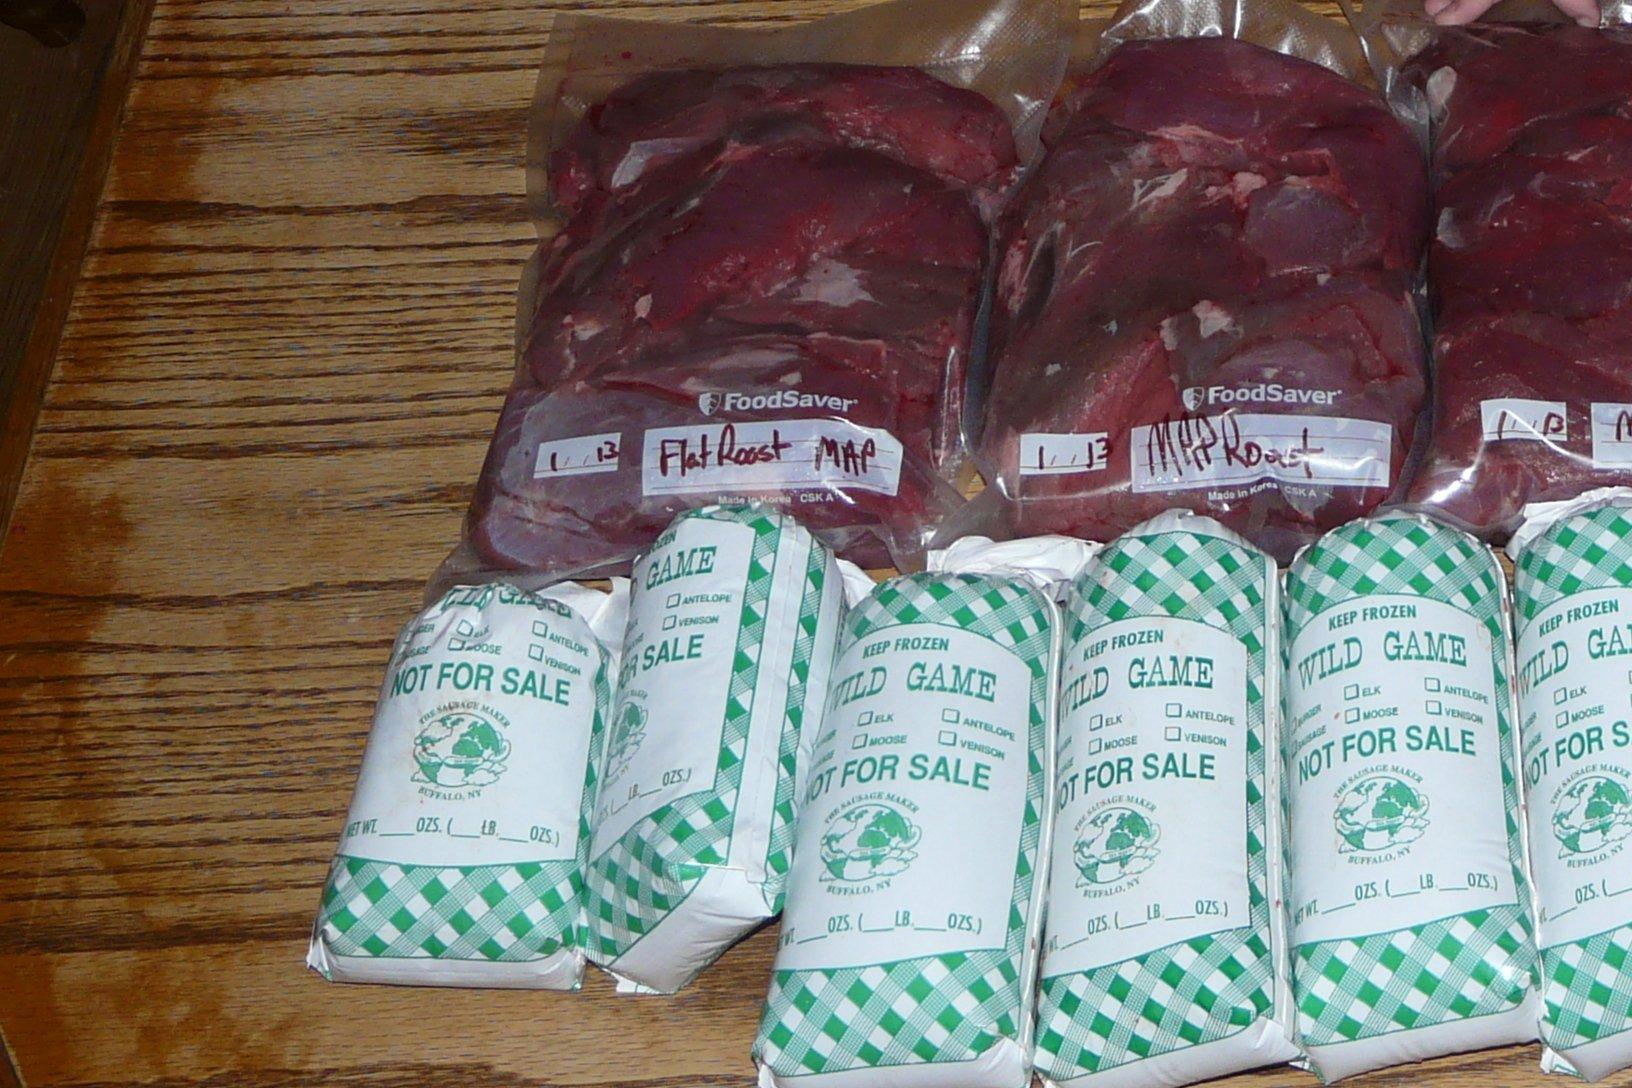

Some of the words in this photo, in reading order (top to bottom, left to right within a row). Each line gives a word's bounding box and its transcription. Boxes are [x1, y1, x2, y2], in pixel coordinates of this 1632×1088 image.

[724, 391, 853, 412] FoodSaver
[1208, 385, 1336, 405] FoodSaver
[597, 441, 619, 462] 13
[660, 439, 709, 477] Flat
[717, 424, 792, 467] Roast
[815, 436, 876, 476] MAP
[1208, 490, 1235, 500] Made
[1238, 488, 1248, 497] in
[1250, 482, 1278, 497] Korea
[646, 546, 717, 591] GAME
[682, 593, 732, 605] ANTELOPE
[678, 615, 719, 627] VENISON
[1329, 611, 1358, 631] KEEP
[1362, 605, 1416, 621] FROZEN
[1539, 615, 1563, 637] KEEP
[1567, 599, 1619, 623] FROZEN
[642, 634, 704, 671] SALE
[862, 641, 890, 659] KEEP
[894, 638, 949, 652] FROZEN
[1083, 640, 1108, 662] KEEP
[1112, 630, 1164, 650] FROZEN
[1299, 637, 1362, 690] WILD
[1384, 630, 1467, 667] GAME
[390, 665, 432, 697] NOT
[436, 662, 494, 691] FOR
[501, 668, 571, 706] SALE
[906, 661, 997, 703] GAME
[1129, 656, 1214, 689] GAME
[1519, 640, 1569, 699] WILD
[1570, 687, 1587, 699] ELK
[436, 701, 480, 714] SAUSAGE
[480, 704, 511, 729] MAKER
[1105, 715, 1123, 727] ELK
[1186, 710, 1235, 726] ANTELOPE
[1572, 705, 1605, 723] MOOSE
[869, 735, 908, 746] MOOSE
[960, 739, 1005, 760] VENISON
[1104, 736, 1138, 751] MOOSE
[1184, 733, 1227, 747] VENISON
[1299, 741, 1334, 786] NOT
[1343, 728, 1396, 762] FOR
[1406, 726, 1476, 756] SALE
[1555, 726, 1604, 767] FOR
[841, 754, 899, 788] FOR
[908, 754, 992, 790] SALE
[1058, 774, 1078, 810] OT
[1085, 757, 1133, 794] FOR
[1143, 752, 1215, 780] SALE
